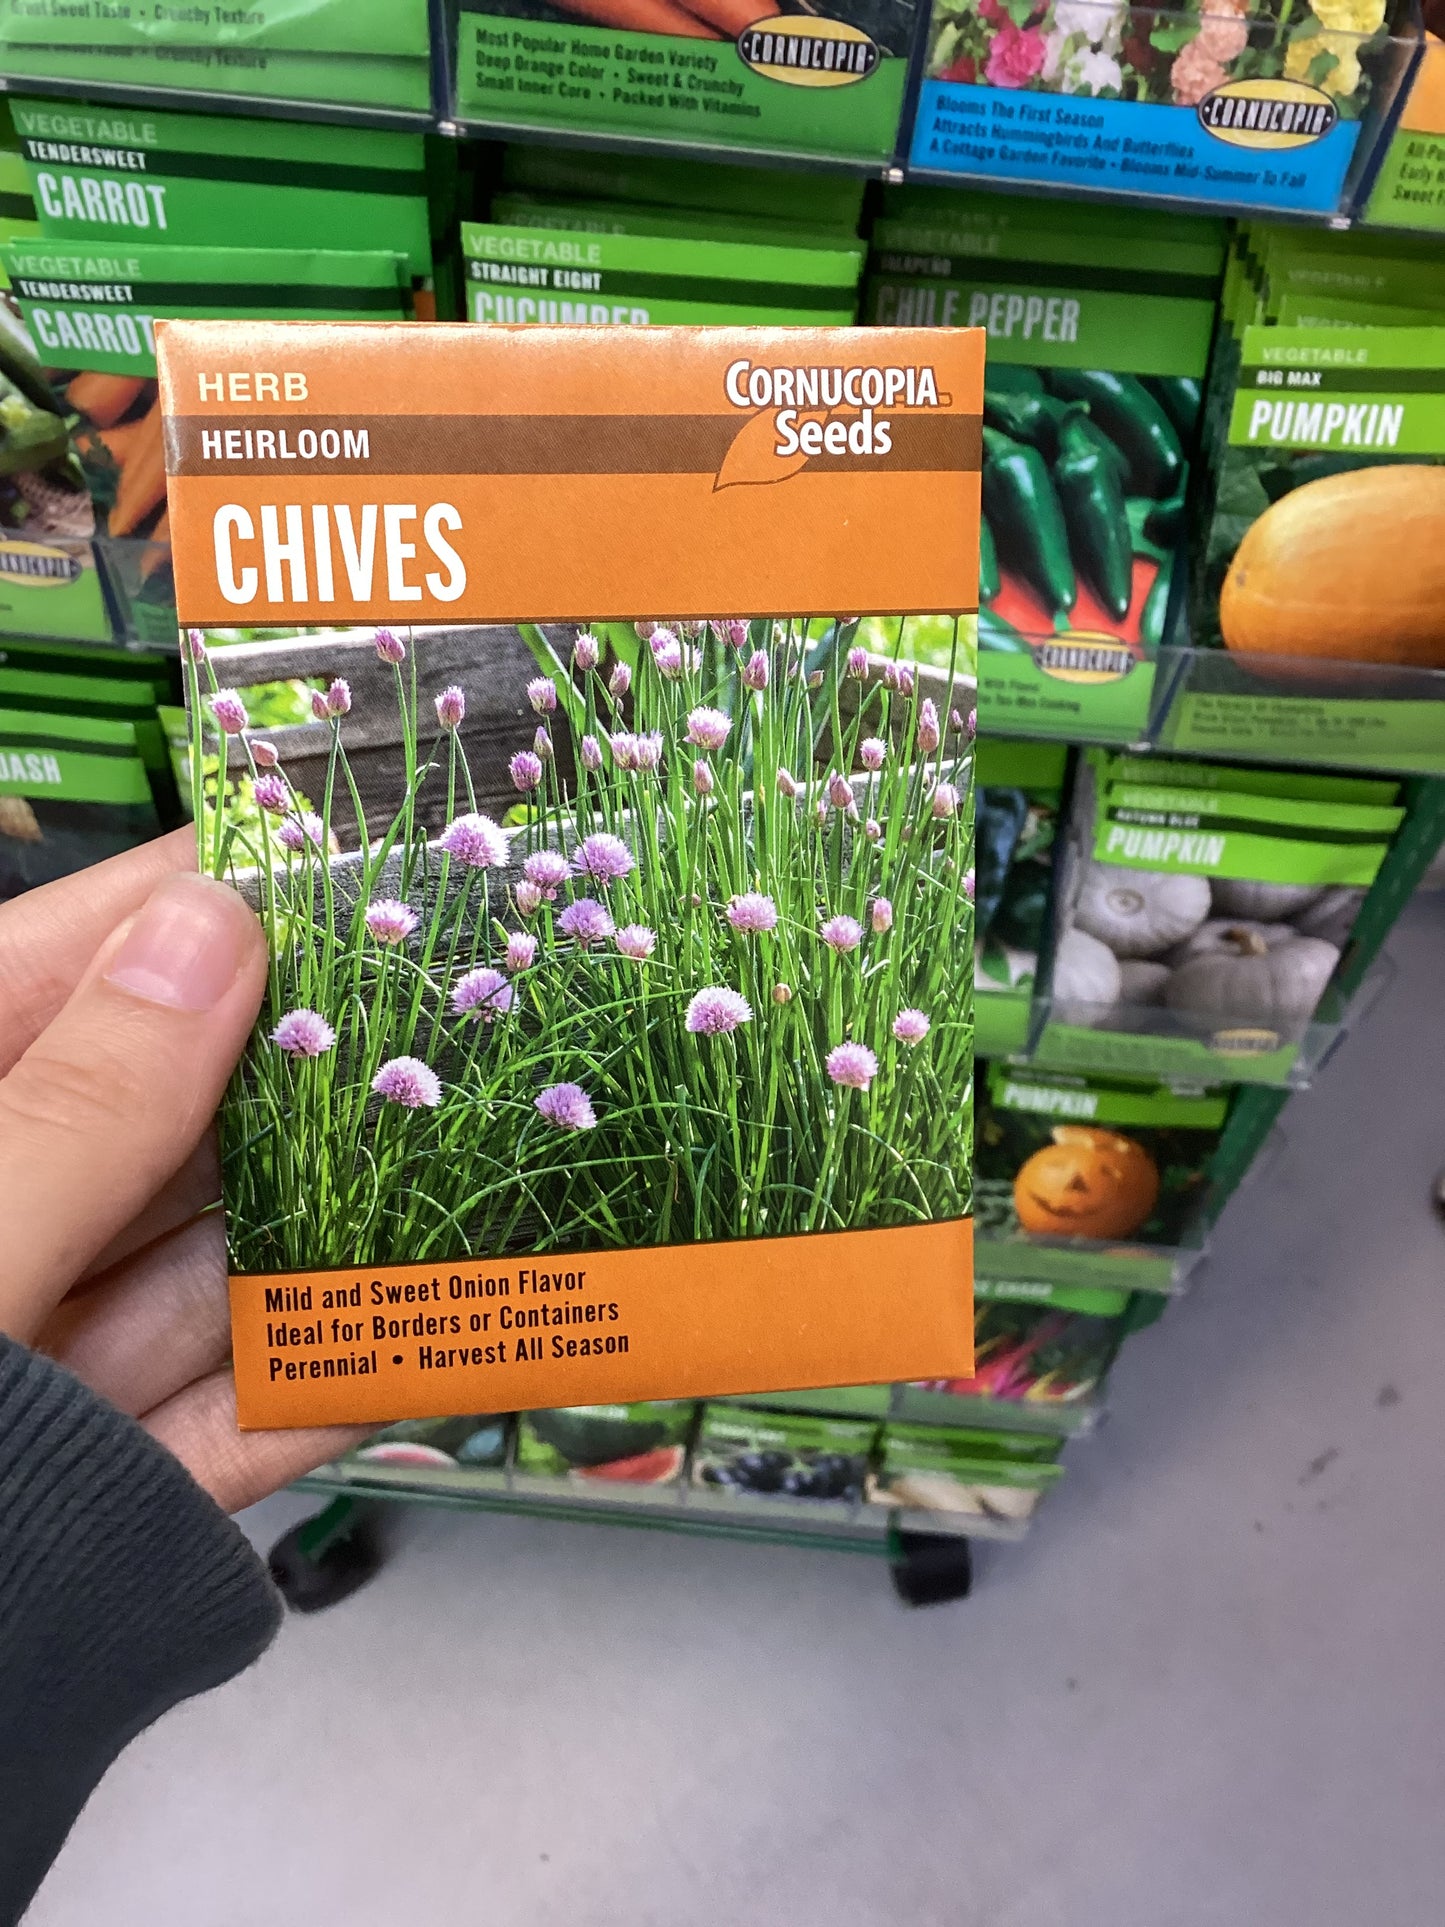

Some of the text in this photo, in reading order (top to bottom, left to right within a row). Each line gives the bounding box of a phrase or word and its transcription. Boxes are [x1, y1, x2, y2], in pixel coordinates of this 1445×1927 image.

[476, 28, 719, 72] Most Popular Home Garden Variety
[751, 33, 867, 72] CORNUCOPIA
[476, 50, 511, 71] Deep
[515, 55, 564, 78] Orange
[569, 61, 604, 80] Color
[627, 67, 669, 87] Sweet
[687, 74, 745, 97] Crunchy
[476, 71, 514, 91] Small
[518, 78, 553, 95] Inner
[558, 81, 591, 99] Core
[613, 87, 665, 107] Packed
[702, 98, 761, 117] Vitamins
[20, 111, 157, 144] VEGETABLE
[936, 95, 1105, 128] Blooms The First Season
[1210, 97, 1326, 134] CORNUCOPIA
[27, 140, 147, 170] TENDERSWEET
[932, 117, 1195, 158] Attracts Hummingbirds And Butterflies
[930, 138, 939, 153] A
[943, 138, 995, 161] Cottage
[999, 145, 1048, 164] Garden
[1052, 151, 1106, 170] Favorite
[1121, 158, 1169, 177] Blooms
[1263, 170, 1278, 187] To
[1281, 171, 1307, 188] Fall
[37, 172, 168, 230] CARROT
[10, 254, 142, 278] VEGETABLE
[469, 234, 601, 264] VEGETABLE
[19, 280, 133, 302] TENDERSWEET
[471, 261, 548, 286] STRAIGHT
[32, 308, 157, 357] CARROT
[968, 291, 1080, 343] PEPPER
[1263, 347, 1368, 364] VEGETABLE
[198, 372, 309, 402] HERB
[726, 361, 938, 406] CORNUCOPIA
[1256, 370, 1322, 387] BIG MAX
[775, 409, 892, 455] Seeds
[1249, 399, 1404, 447] PUMPKIN
[201, 429, 370, 460] HEIRLOOM
[213, 502, 467, 605] CHIVES
[1106, 826, 1226, 867] PUMPKIN
[265, 1269, 587, 1313] Mild and Sweet Onion Flavor
[266, 1301, 619, 1348] Ideal for Borders or Containers
[269, 1334, 629, 1382] Perennial Harvest All Season
